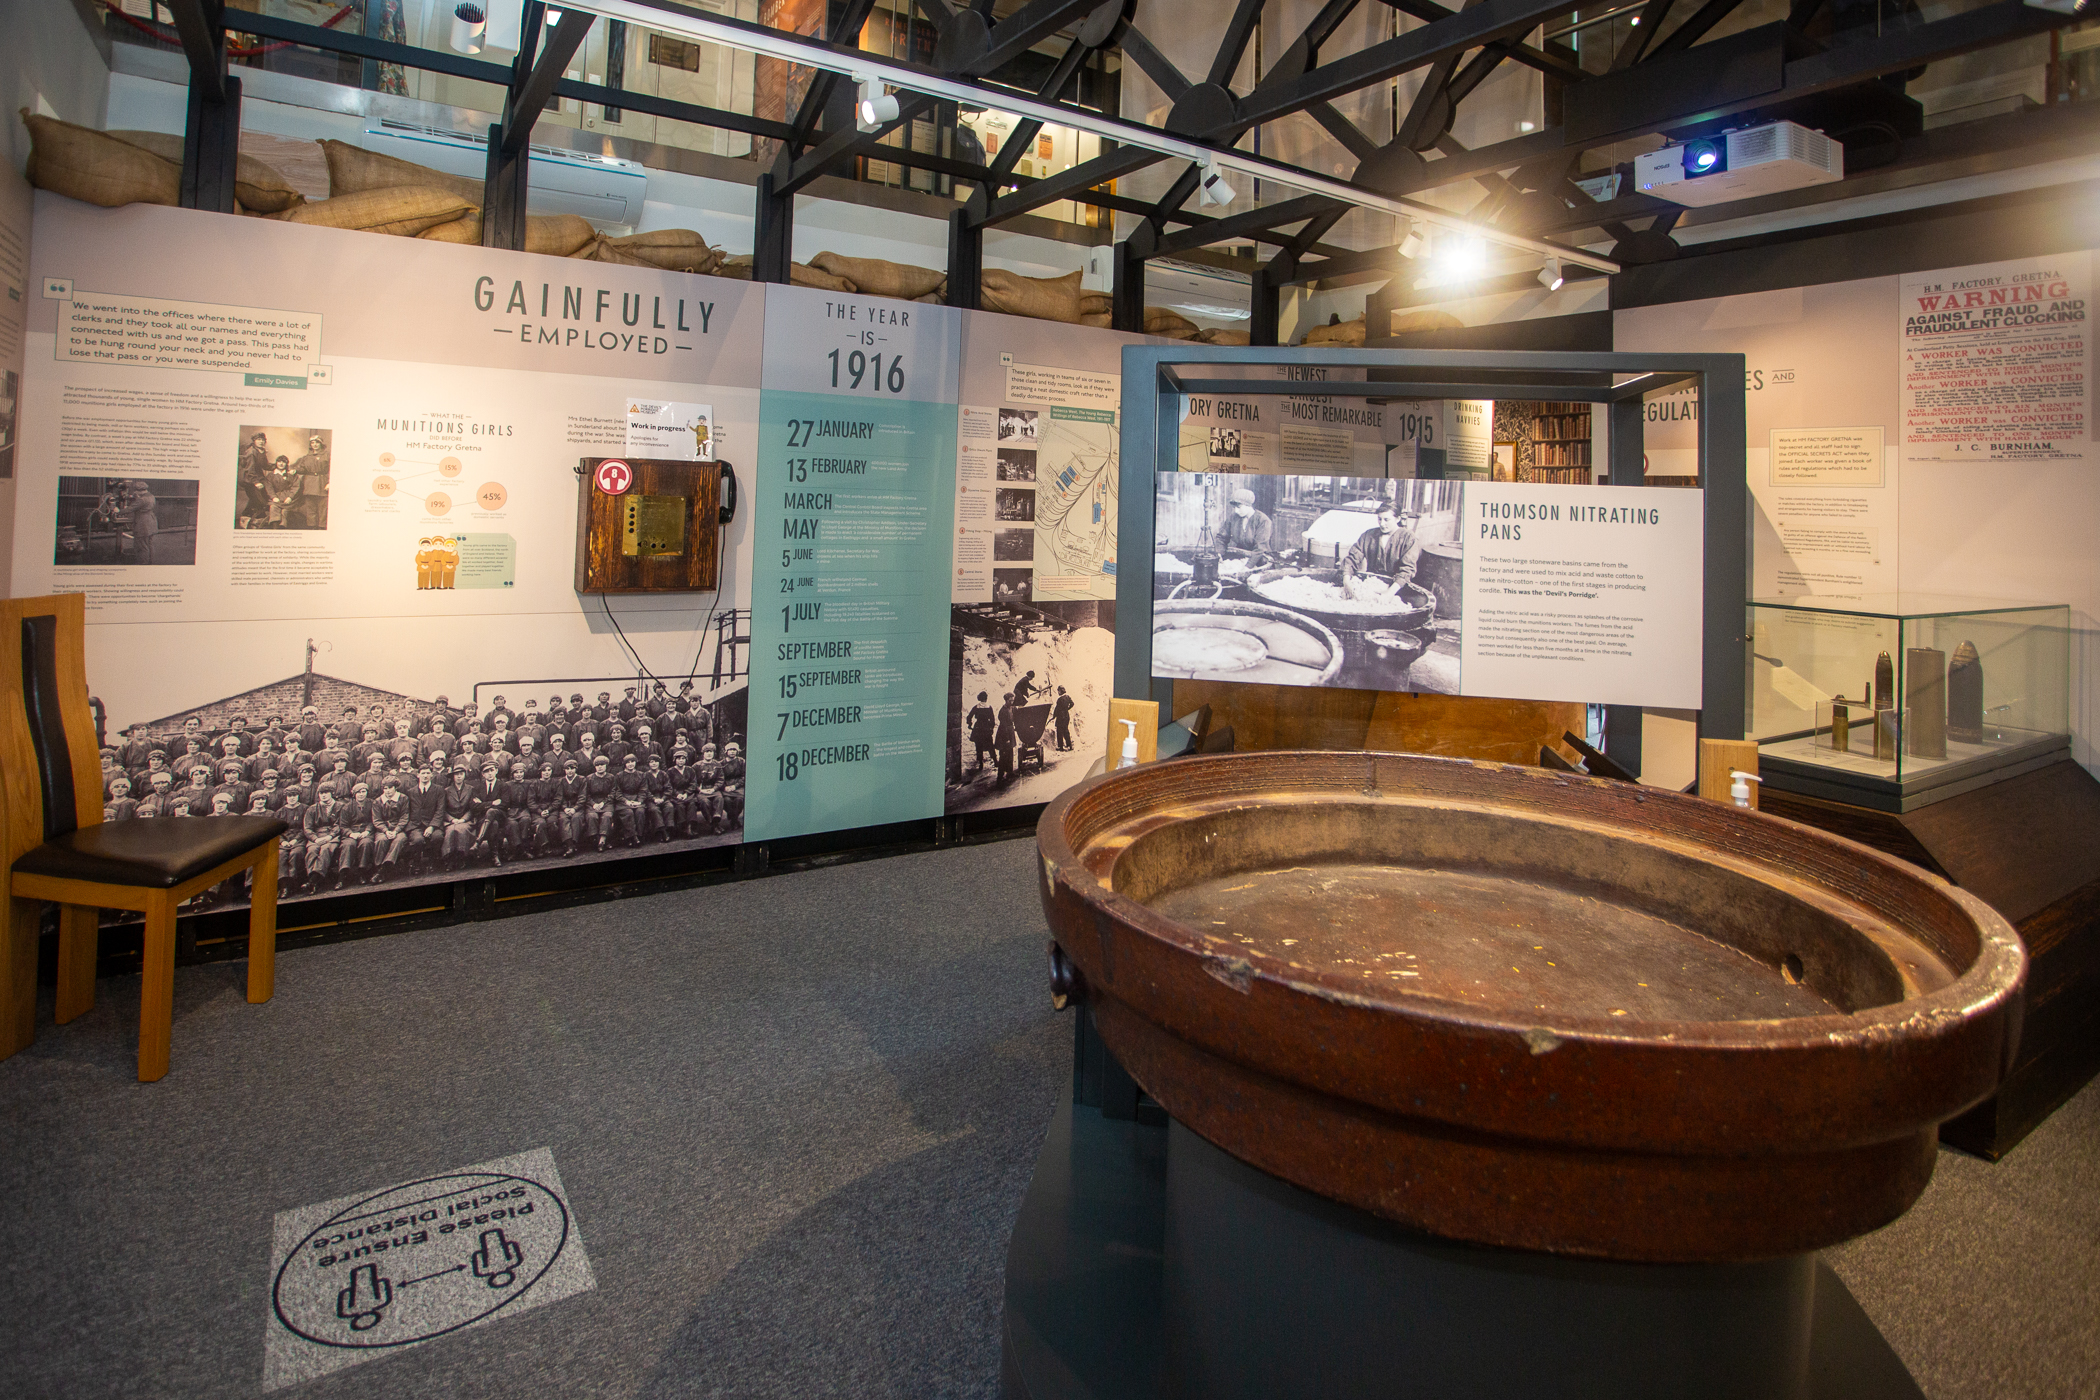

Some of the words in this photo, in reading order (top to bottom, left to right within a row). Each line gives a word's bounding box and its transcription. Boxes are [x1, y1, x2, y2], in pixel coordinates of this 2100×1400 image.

[475, 276, 714, 334] GAINFULLY
[1918, 282, 2069, 311] WARNING
[73, 301, 89, 310] We
[121, 307, 140, 315] into
[143, 309, 160, 317] the
[162, 311, 194, 320] offices
[197, 314, 226, 323] where
[228, 317, 252, 325] there
[287, 321, 299, 329] lot
[826, 302, 856, 321] THE
[869, 308, 909, 327] YEAR
[1906, 319, 2000, 335] FRAUDULENT
[2004, 311, 2085, 327] CLOCKING
[1907, 311, 1973, 326] AGAINST
[1983, 305, 2039, 319] FRAUD
[2050, 300, 2085, 312] AND
[71, 327, 124, 336] connected
[201, 338, 216, 346] got
[252, 340, 269, 348] This
[294, 341, 309, 351] had
[72, 314, 102, 323] clerks
[126, 319, 148, 329] they
[176, 323, 188, 331] all
[210, 327, 239, 335] names
[260, 332, 306, 342] everything
[521, 324, 668, 355] EMPLOYED
[861, 331, 875, 346] IS
[1921, 350, 1968, 360] WORKER
[1977, 348, 2003, 356] WAS
[2011, 341, 2083, 354] CONVICTED
[255, 378, 274, 386] Emily
[828, 349, 904, 393] 1916
[1772, 373, 1795, 381] AND
[1217, 400, 1259, 421] GRETNA
[1292, 403, 1319, 421] MOST
[1323, 406, 1382, 428] REMARKABLE
[1454, 402, 1483, 413] DRINKING
[378, 419, 463, 434] MUNITIONS
[472, 424, 513, 437] GIRLS
[658, 425, 686, 433] progress
[1400, 413, 1432, 444] 1915
[1456, 416, 1481, 426] NAVVIES
[787, 419, 815, 447] 27
[816, 420, 874, 439] JANUARY
[423, 443, 453, 452] Factory
[455, 444, 482, 452] Gretna
[611, 469, 618, 478] 8
[787, 459, 807, 483] 13
[812, 458, 867, 475] FEBRUARY
[483, 493, 502, 501] 45%
[785, 493, 832, 510] MARCH
[1480, 503, 1559, 521] THOMSON
[1570, 506, 1659, 525] NITRATING
[784, 519, 819, 539] MAY
[1481, 524, 1521, 541] PANS
[782, 550, 790, 568] 5
[793, 549, 813, 560] JUNE
[1513, 558, 1528, 566] large
[1480, 567, 1501, 575] factory
[781, 579, 795, 593] 24
[797, 577, 814, 587] JUNE
[1615, 584, 1646, 592] producing
[782, 605, 790, 633] 1
[792, 603, 821, 621] JULY
[778, 641, 852, 661] SEPTEMBER
[779, 675, 797, 698] 15
[799, 670, 861, 688] SEPTEMBER
[777, 713, 790, 741] 7
[793, 706, 861, 728] DECEMBER
[777, 752, 798, 782] 18
[802, 744, 870, 767] DECEMBER
[448, 1186, 527, 1216] Social
[312, 1208, 438, 1249] Distance
[438, 1202, 535, 1234] Please
[318, 1230, 429, 1267] Ensure
